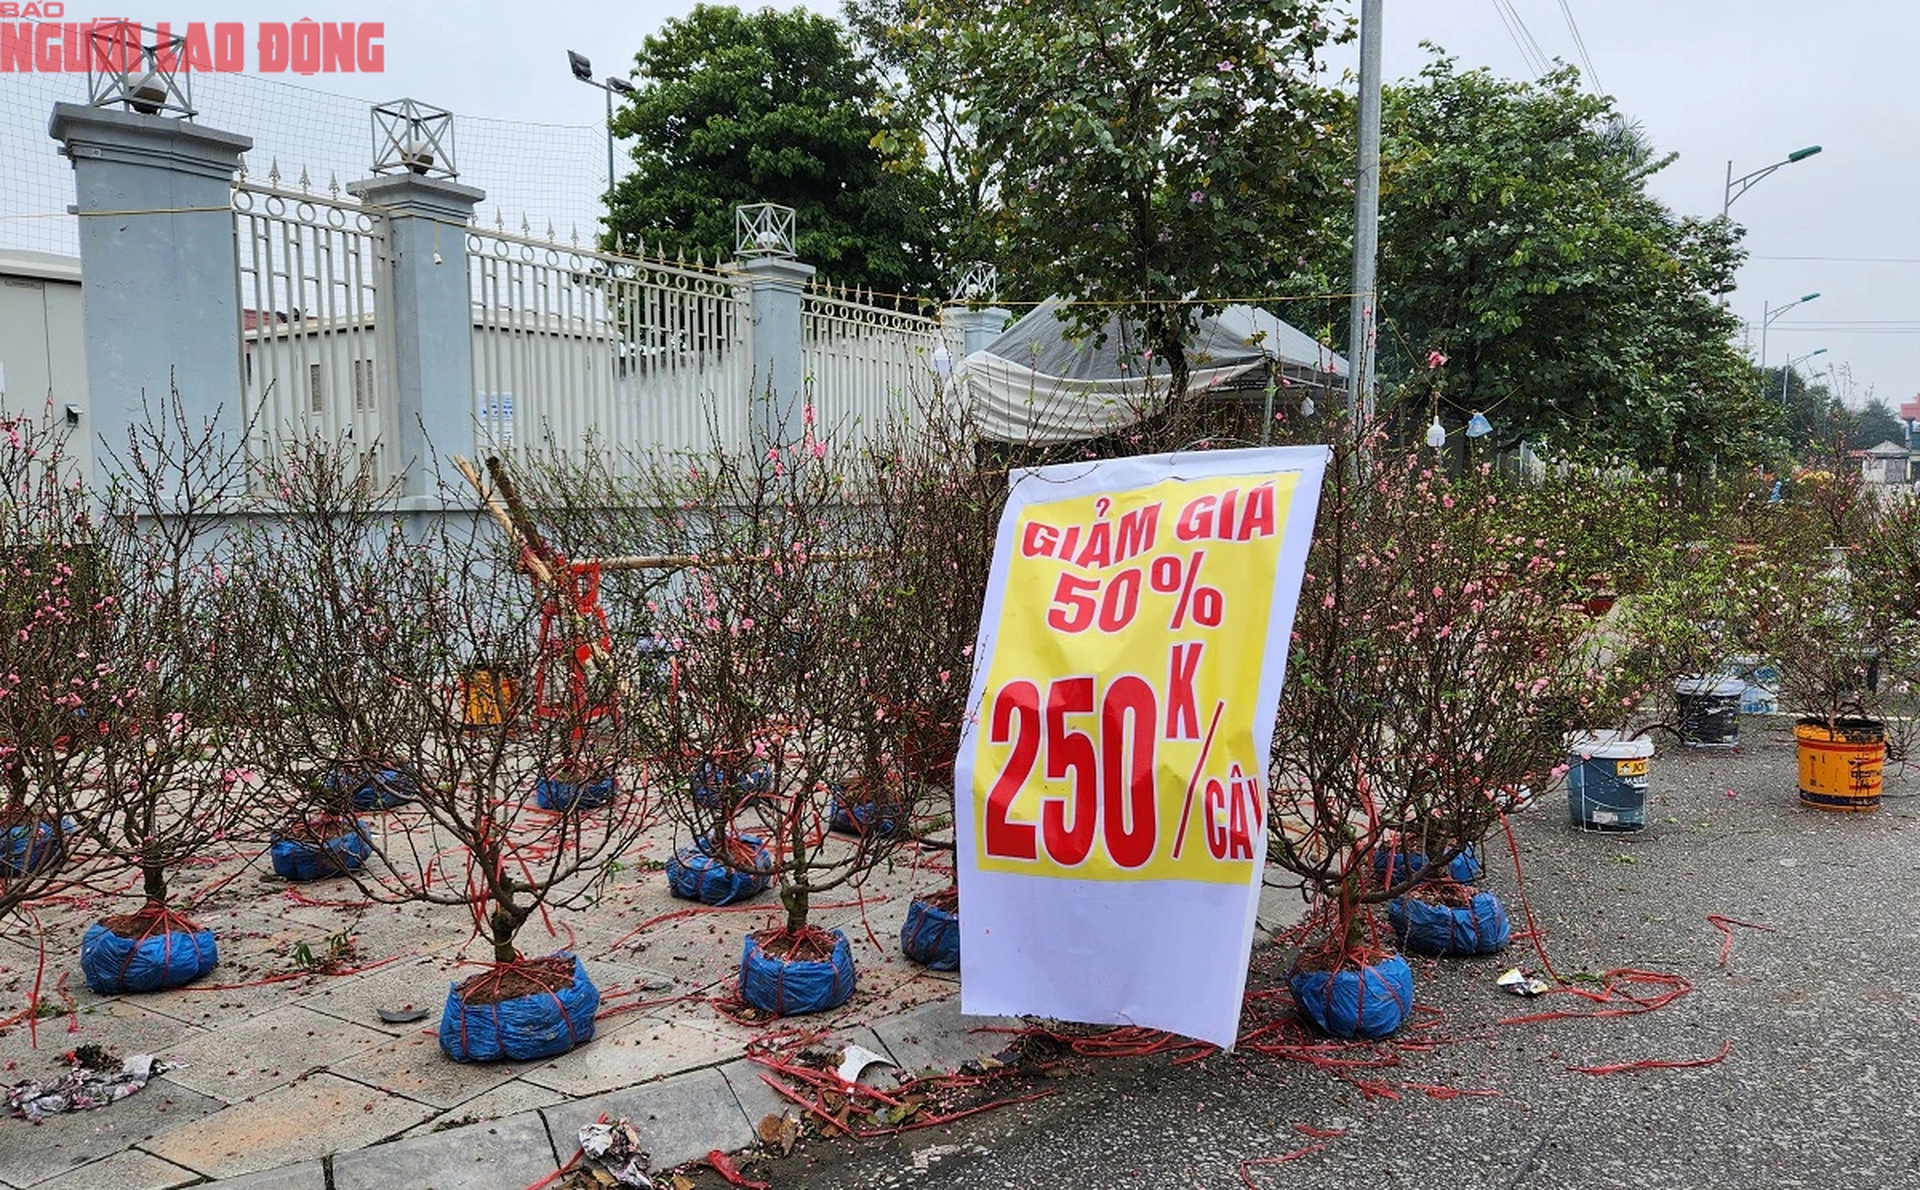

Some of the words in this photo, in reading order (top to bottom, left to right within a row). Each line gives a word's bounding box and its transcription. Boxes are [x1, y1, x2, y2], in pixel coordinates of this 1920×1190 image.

[1021, 496, 1163, 570] GIẢM
[1176, 480, 1276, 542] GIÁ
[1047, 551, 1224, 634] 50%
